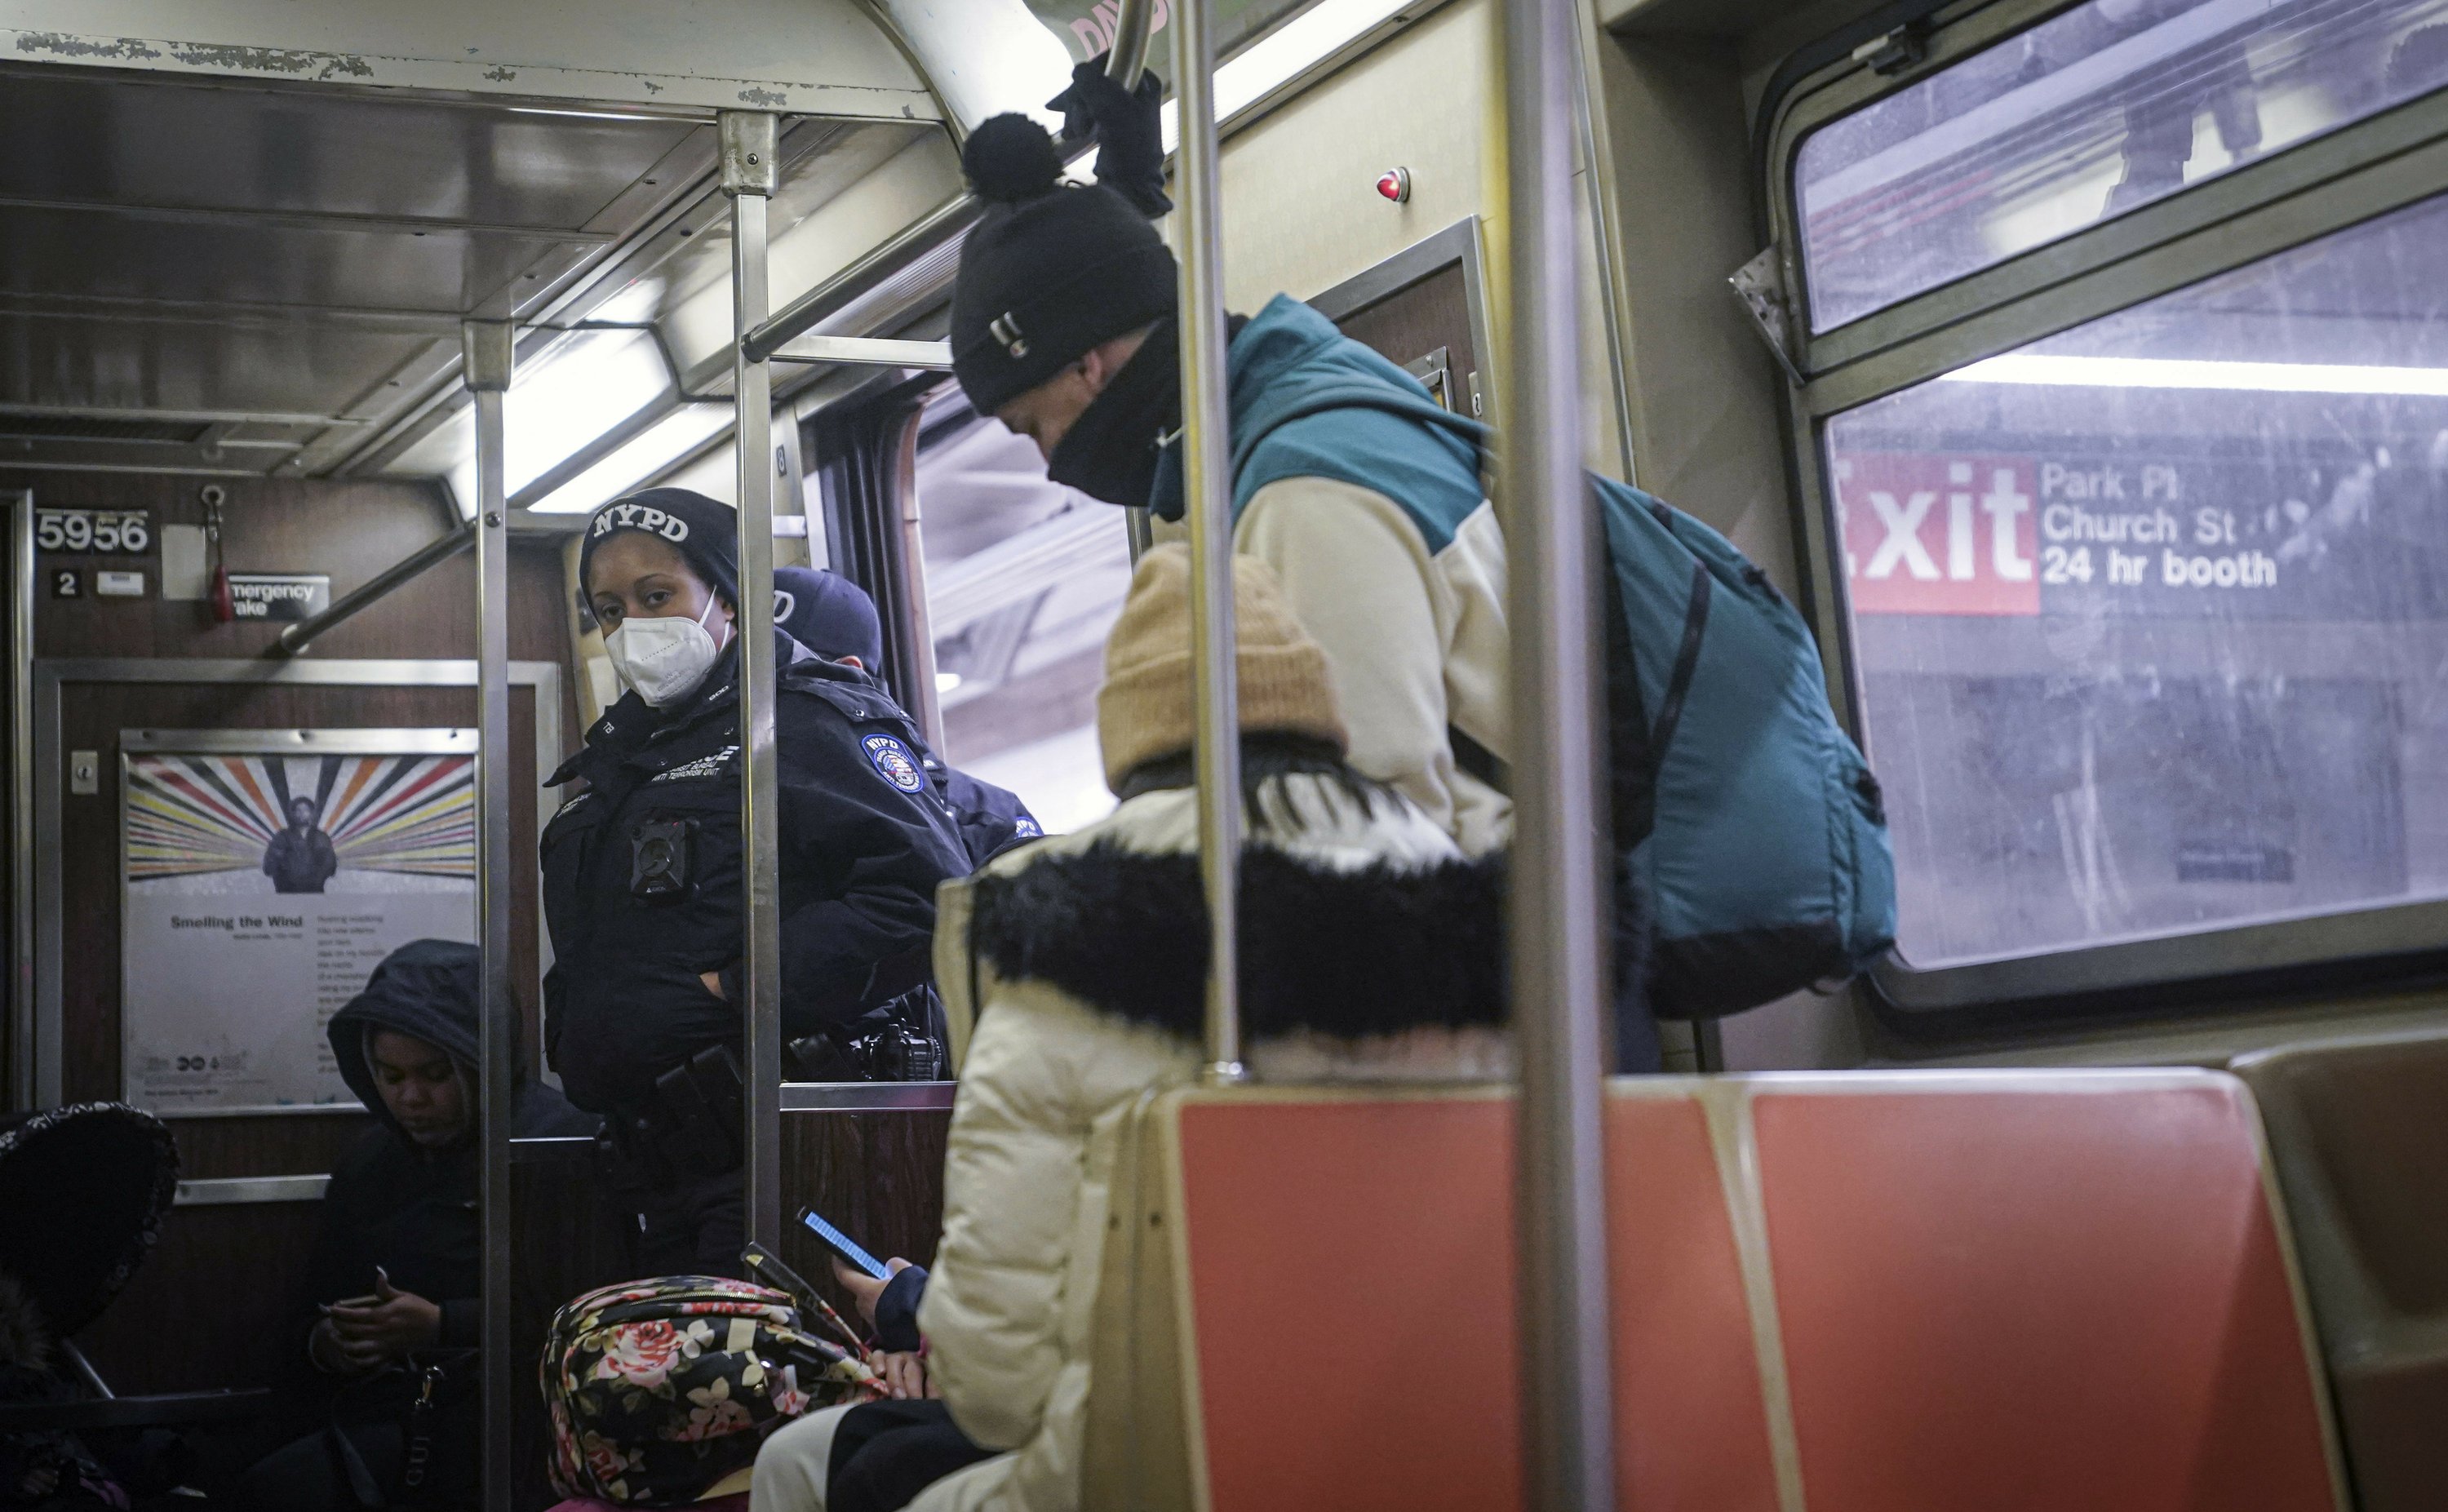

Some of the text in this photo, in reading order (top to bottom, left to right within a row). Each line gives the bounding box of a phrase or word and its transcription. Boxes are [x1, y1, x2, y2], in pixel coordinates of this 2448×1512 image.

[2042, 462, 2123, 499] Park
[38, 514, 149, 552] 5956
[593, 503, 689, 543] NYPD
[2044, 503, 2236, 546] Church St
[2044, 545, 2277, 588] 24 hr booth
[59, 572, 76, 595] 2
[231, 583, 313, 602] mergency
[233, 599, 268, 616] ake
[866, 738, 899, 751] NYPD
[703, 768, 720, 776] UNIT
[171, 915, 234, 931] Smelling
[239, 916, 263, 928] the
[268, 915, 304, 928] Wind
